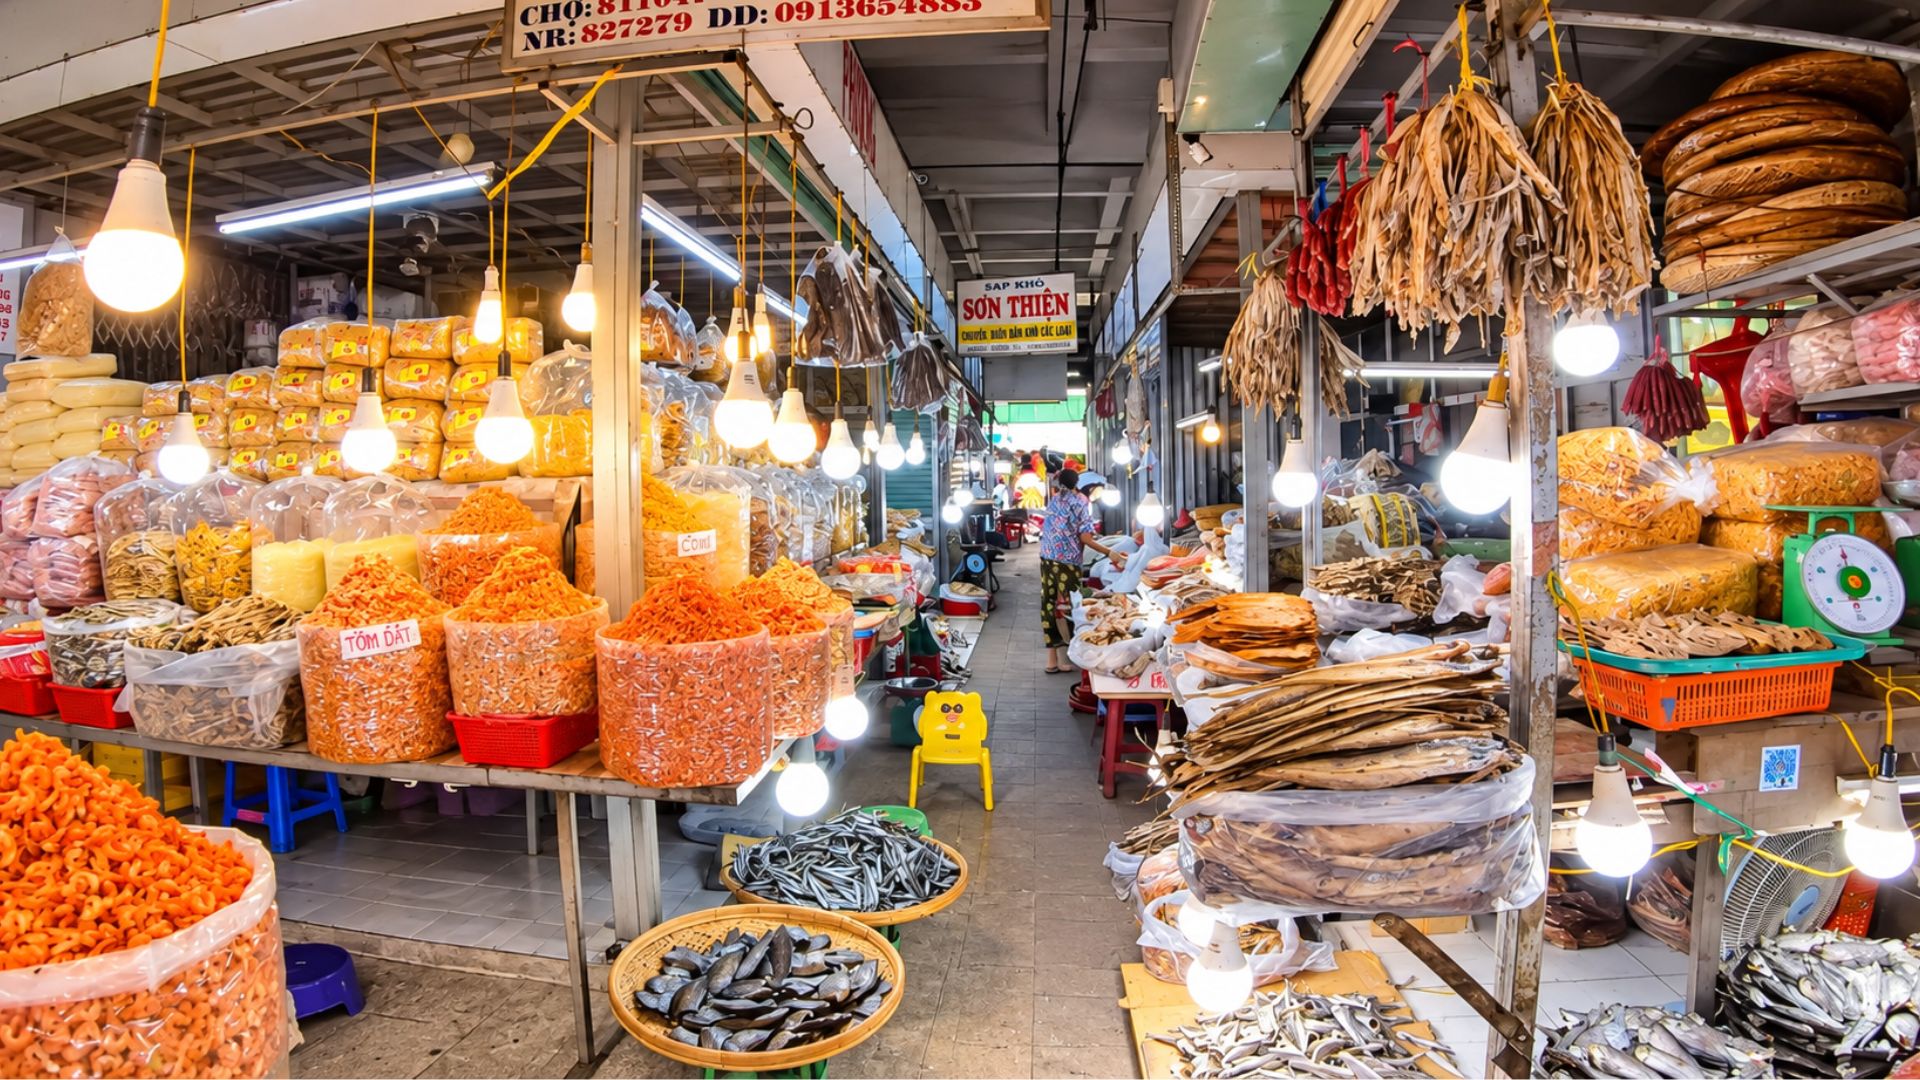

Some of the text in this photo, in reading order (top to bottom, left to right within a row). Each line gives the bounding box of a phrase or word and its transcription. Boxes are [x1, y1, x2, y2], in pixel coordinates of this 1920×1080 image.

[523, 28, 576, 51] NR:
[581, 12, 693, 43] 827279
[707, 4, 769, 28] DD:
[962, 287, 1070, 322] SƠN THIỆN
